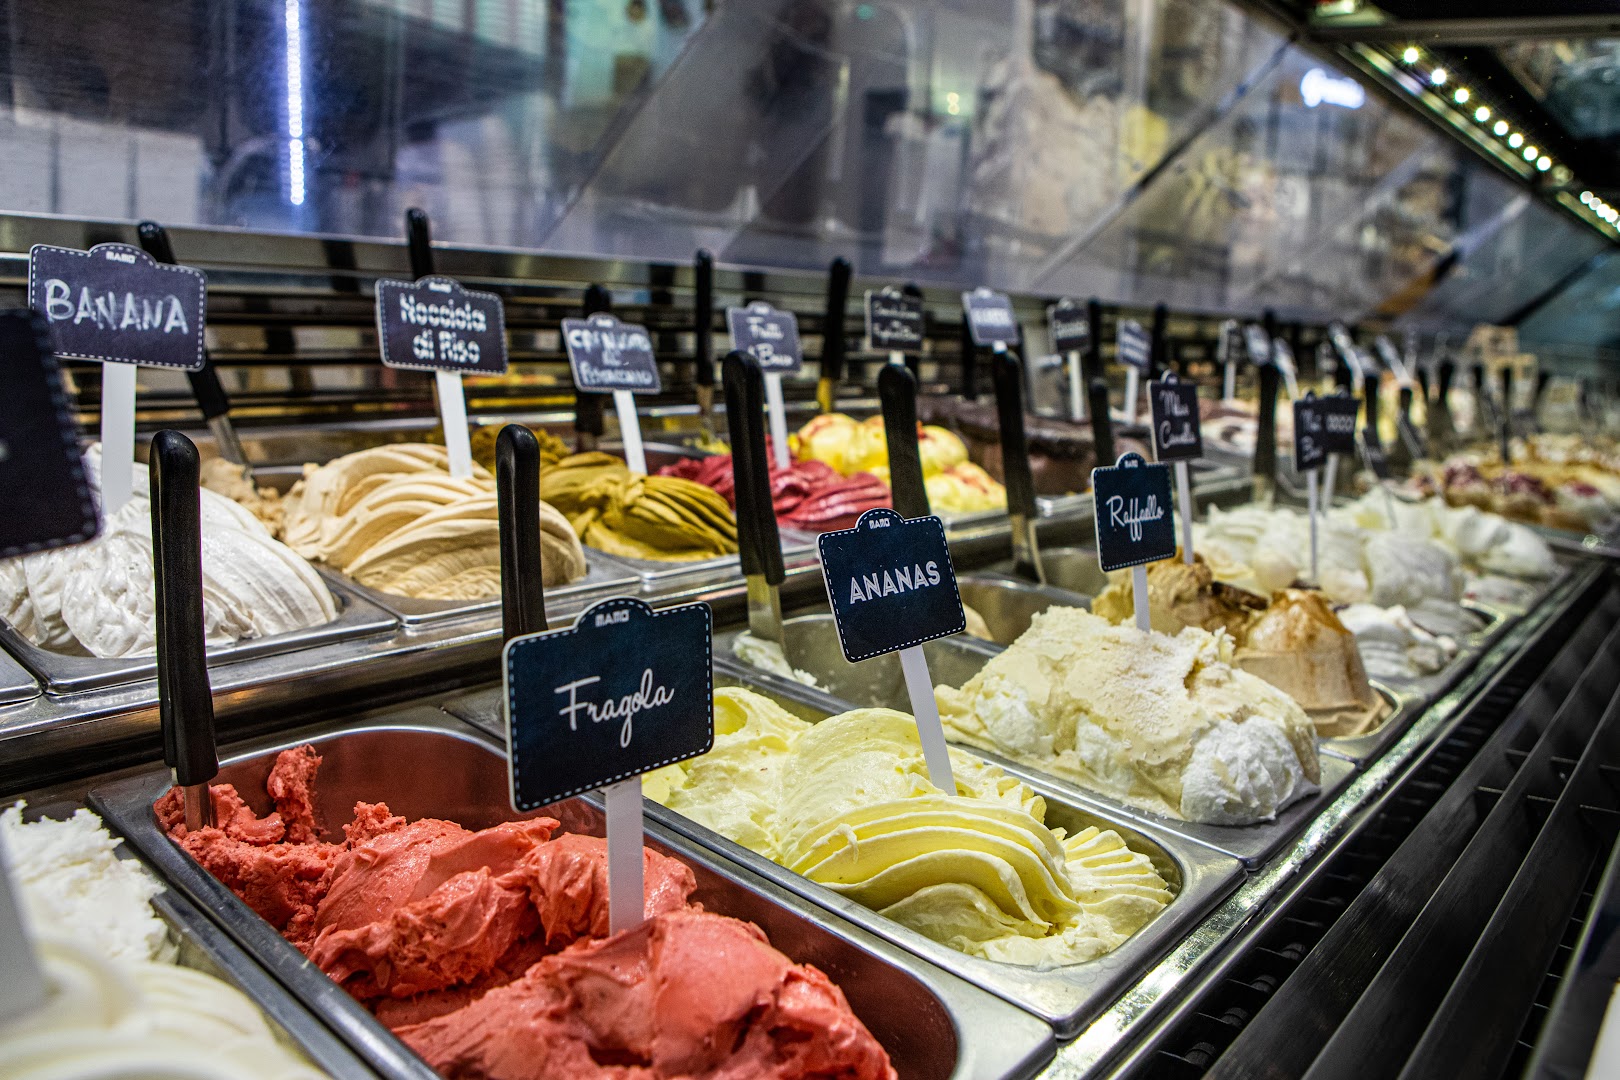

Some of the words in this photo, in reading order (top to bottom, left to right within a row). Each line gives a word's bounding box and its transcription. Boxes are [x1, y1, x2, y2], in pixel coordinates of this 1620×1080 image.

[44, 279, 189, 335] BANANA
[400, 293, 487, 332] Nocciola
[413, 329, 435, 360] di
[438, 331, 480, 364] Riso
[1106, 494, 1164, 542] Raffaello
[849, 560, 941, 605] ANANAS
[554, 668, 675, 748] Fragola
